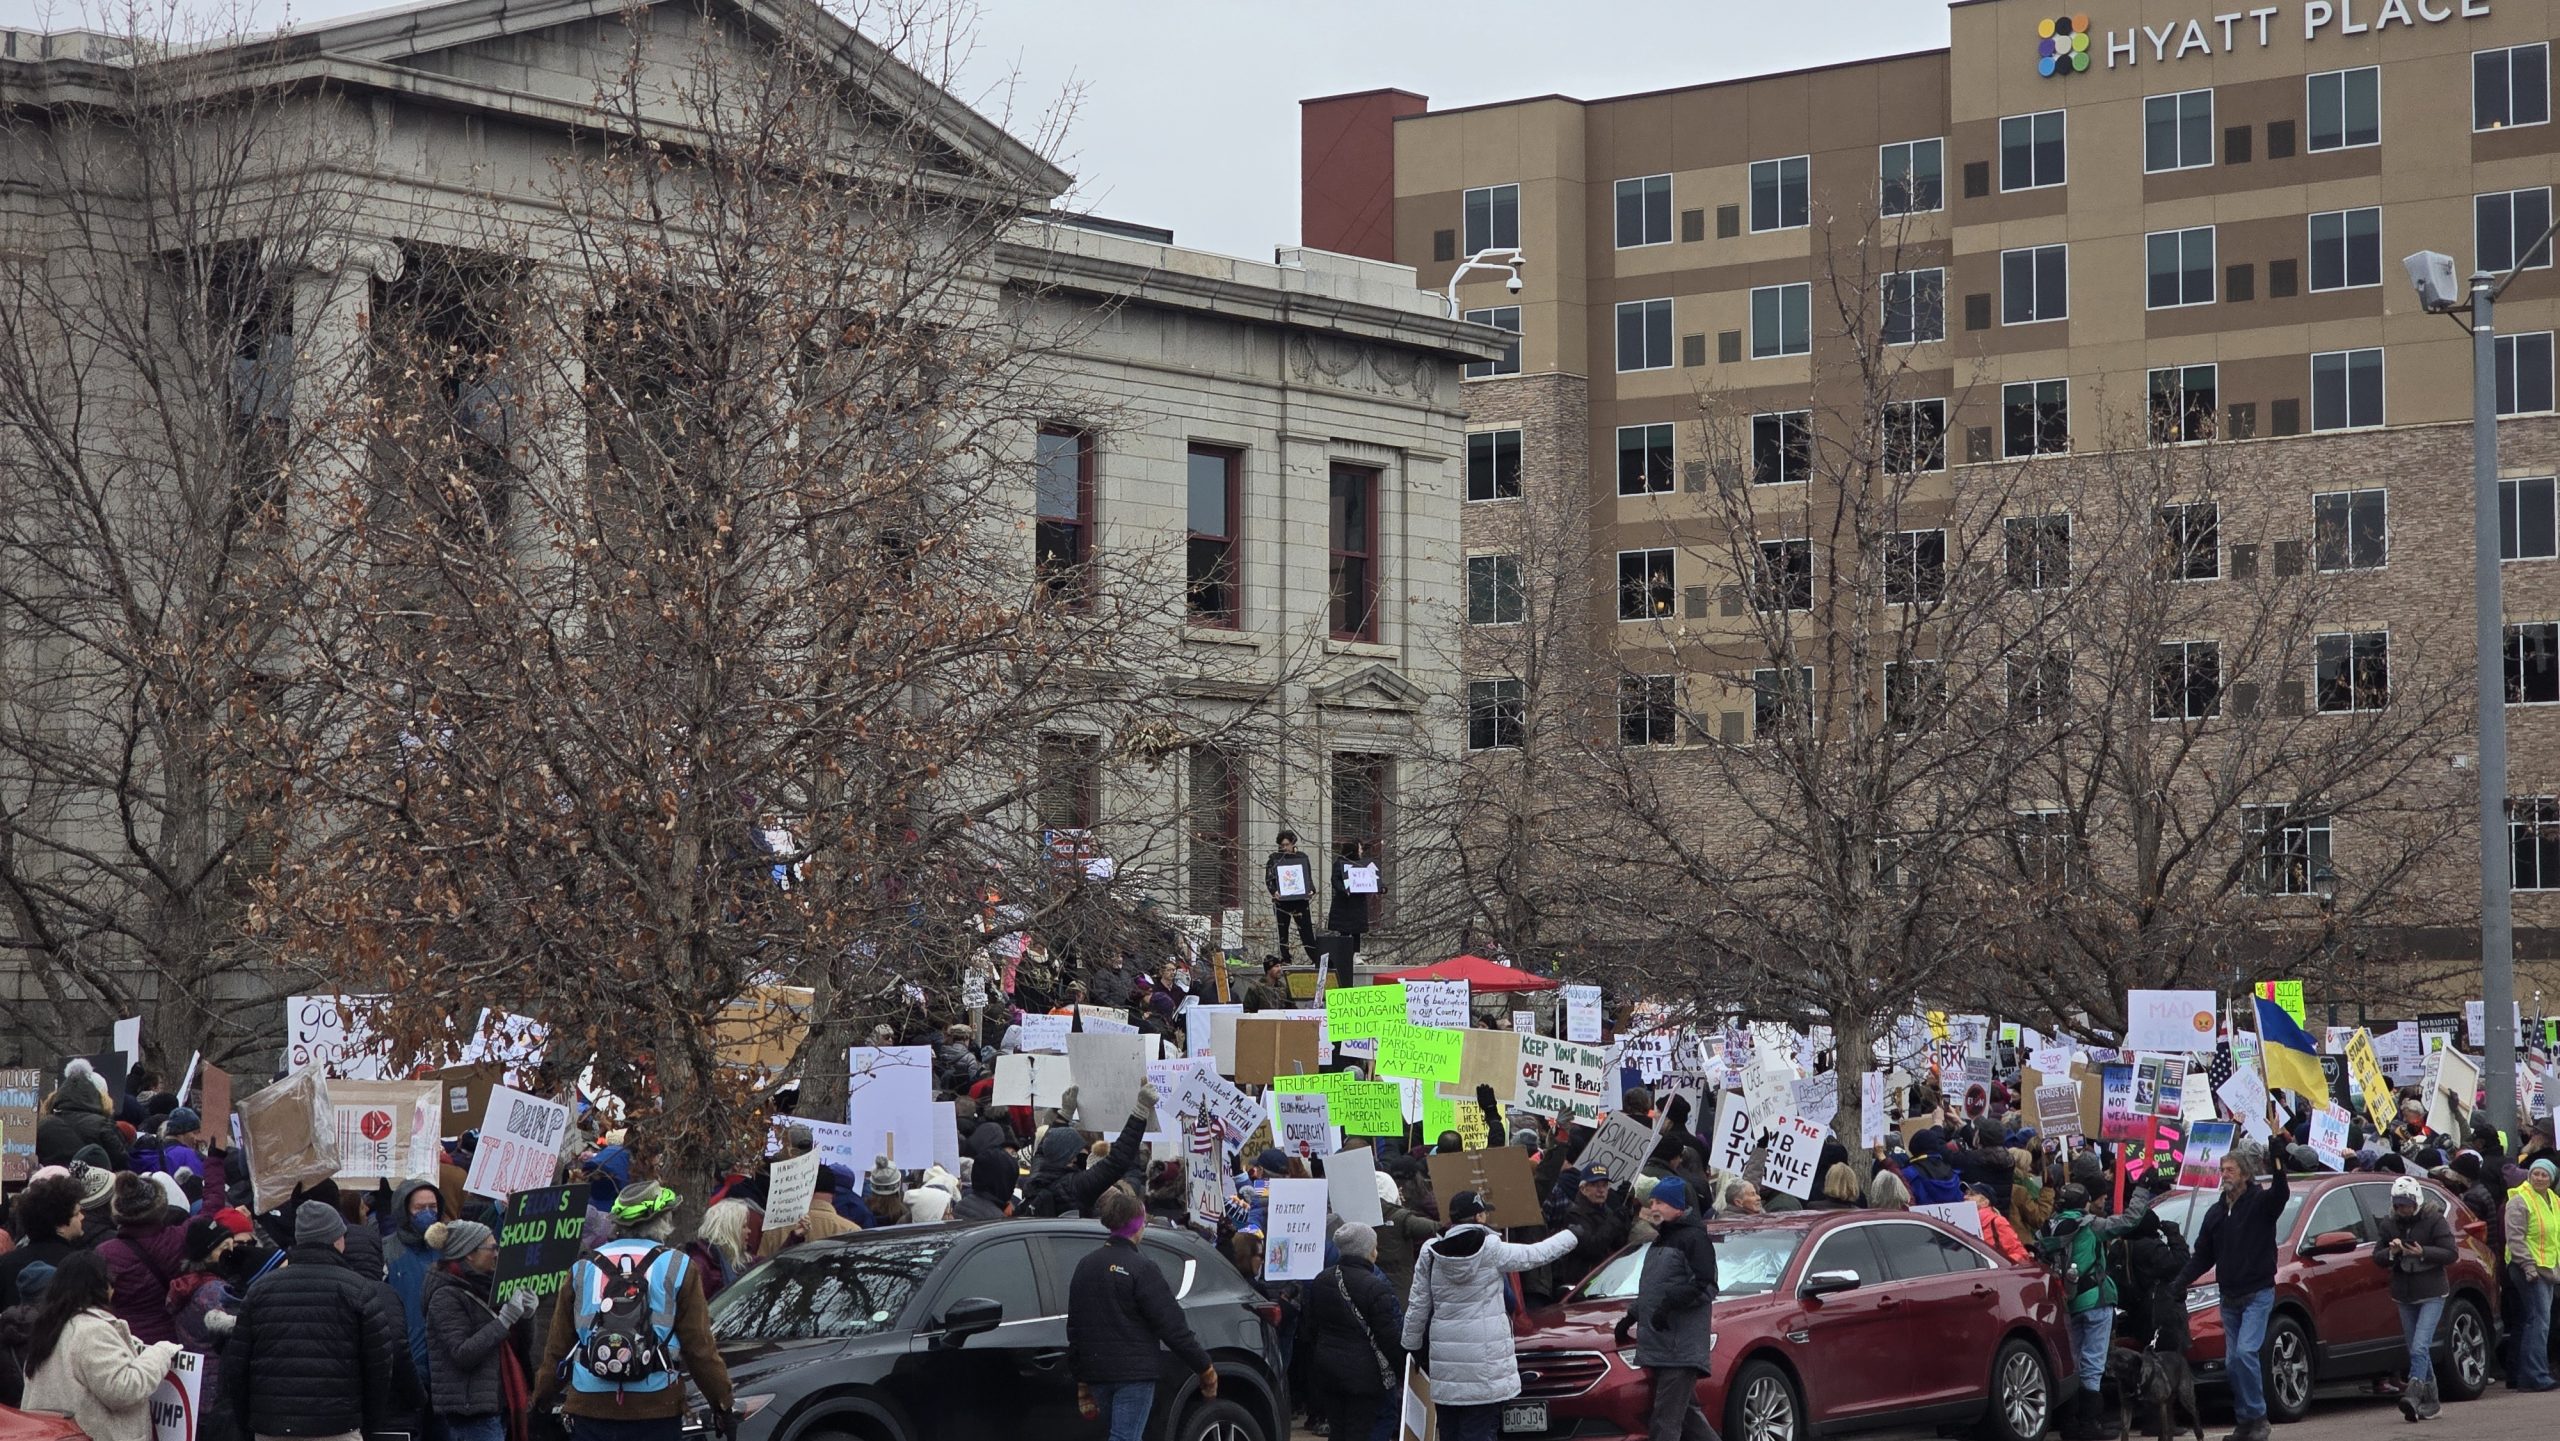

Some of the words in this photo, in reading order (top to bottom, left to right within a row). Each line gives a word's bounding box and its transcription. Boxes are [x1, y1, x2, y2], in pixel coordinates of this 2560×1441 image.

[2107, 7, 2278, 68] HYATT
[1406, 984, 1430, 993] Don't
[1433, 985, 1442, 993] let
[2277, 983, 2300, 996] STOP
[1328, 991, 1387, 1006] CONGRESS
[1424, 995, 1429, 1005] 6
[2280, 1000, 2297, 1012] THE
[1436, 1007, 1463, 1019] Country
[2150, 1002, 2194, 1019] MAD
[1329, 1022, 1351, 1035] THE
[1435, 1018, 1467, 1026] businesses
[1382, 1024, 1421, 1039] HANDS
[1425, 1029, 1442, 1042] OFF
[1446, 1032, 1461, 1046] VA
[2144, 1031, 2195, 1047] SIGN
[1381, 1037, 1416, 1050] PARKS
[1623, 1039, 1661, 1051] HANDS
[1393, 1049, 1447, 1064] EDUCATION
[1522, 1035, 1548, 1057] KEEP
[1554, 1042, 1577, 1063] YOUR
[1581, 1049, 1603, 1069] HANDS
[1940, 1044, 1967, 1067] RFK
[2040, 1055, 2061, 1064] STOP
[1383, 1060, 1406, 1071] MY
[1411, 1062, 1435, 1075] IRA
[1625, 1057, 1661, 1072] OFF!
[2382, 1063, 2399, 1073] OFF
[6, 1071, 40, 1088] LIKE
[1523, 1062, 1543, 1080] OFF
[1549, 1067, 1570, 1086] THE
[1276, 1077, 1320, 1092] TRUMP
[1343, 1083, 1371, 1096] REJECT
[1373, 1083, 1398, 1096] TRUMP
[2109, 1084, 2131, 1093] CARE
[1194, 1068, 1231, 1101] President
[1230, 1095, 1252, 1118] Musk
[2037, 1088, 2060, 1100] HANDS
[2060, 1085, 2073, 1097] OFF
[1345, 1098, 1399, 1110] THREATENING
[1526, 1089, 1566, 1112] SACRED
[2108, 1097, 2126, 1107] NOT
[507, 1099, 564, 1146] DUMP
[1225, 1109, 1253, 1132] PUTIN
[1345, 1111, 1381, 1121] AMERICAN
[818, 1128, 840, 1138] man
[1286, 1122, 1325, 1141] OLIGARCHY
[1457, 1124, 1479, 1132] GOING
[1733, 1110, 1794, 1152] DMB
[1794, 1118, 1819, 1139] THE
[822, 1144, 834, 1153] our
[1728, 1133, 1811, 1177] JUENILE
[2200, 1147, 2211, 1162] IS
[474, 1136, 557, 1193] TRUMP
[2154, 1153, 2171, 1162] OUR
[1193, 1162, 1217, 1181] Justice
[1726, 1150, 1798, 1189] TYANT
[519, 1190, 571, 1216] FELONS
[1200, 1191, 1220, 1214] ALL
[1275, 1203, 1304, 1214] FOXTROT
[500, 1218, 547, 1247] SHOULD
[554, 1217, 586, 1240] NOT
[1287, 1223, 1310, 1233] DELTA
[1294, 1242, 1317, 1252] TANGO
[525, 1245, 539, 1265] BE
[497, 1271, 568, 1303] PRESIDENT
